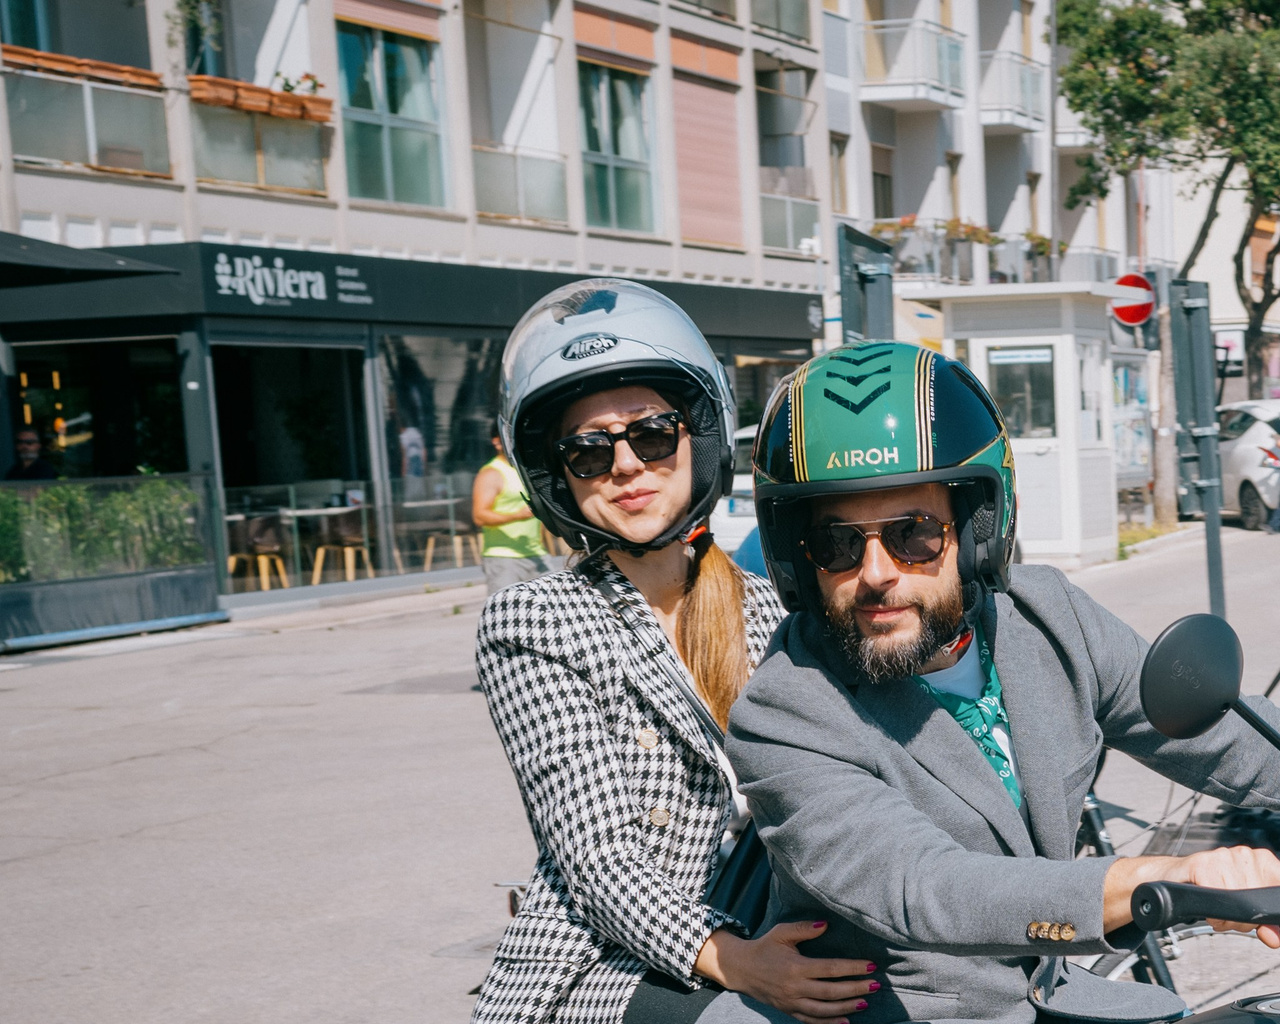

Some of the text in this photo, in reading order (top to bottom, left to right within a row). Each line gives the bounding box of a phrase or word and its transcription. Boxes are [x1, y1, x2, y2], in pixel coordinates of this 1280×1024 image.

[233, 255, 328, 305] Riviera
[566, 338, 615, 358] Airoh
[826, 447, 899, 469] AIROH
